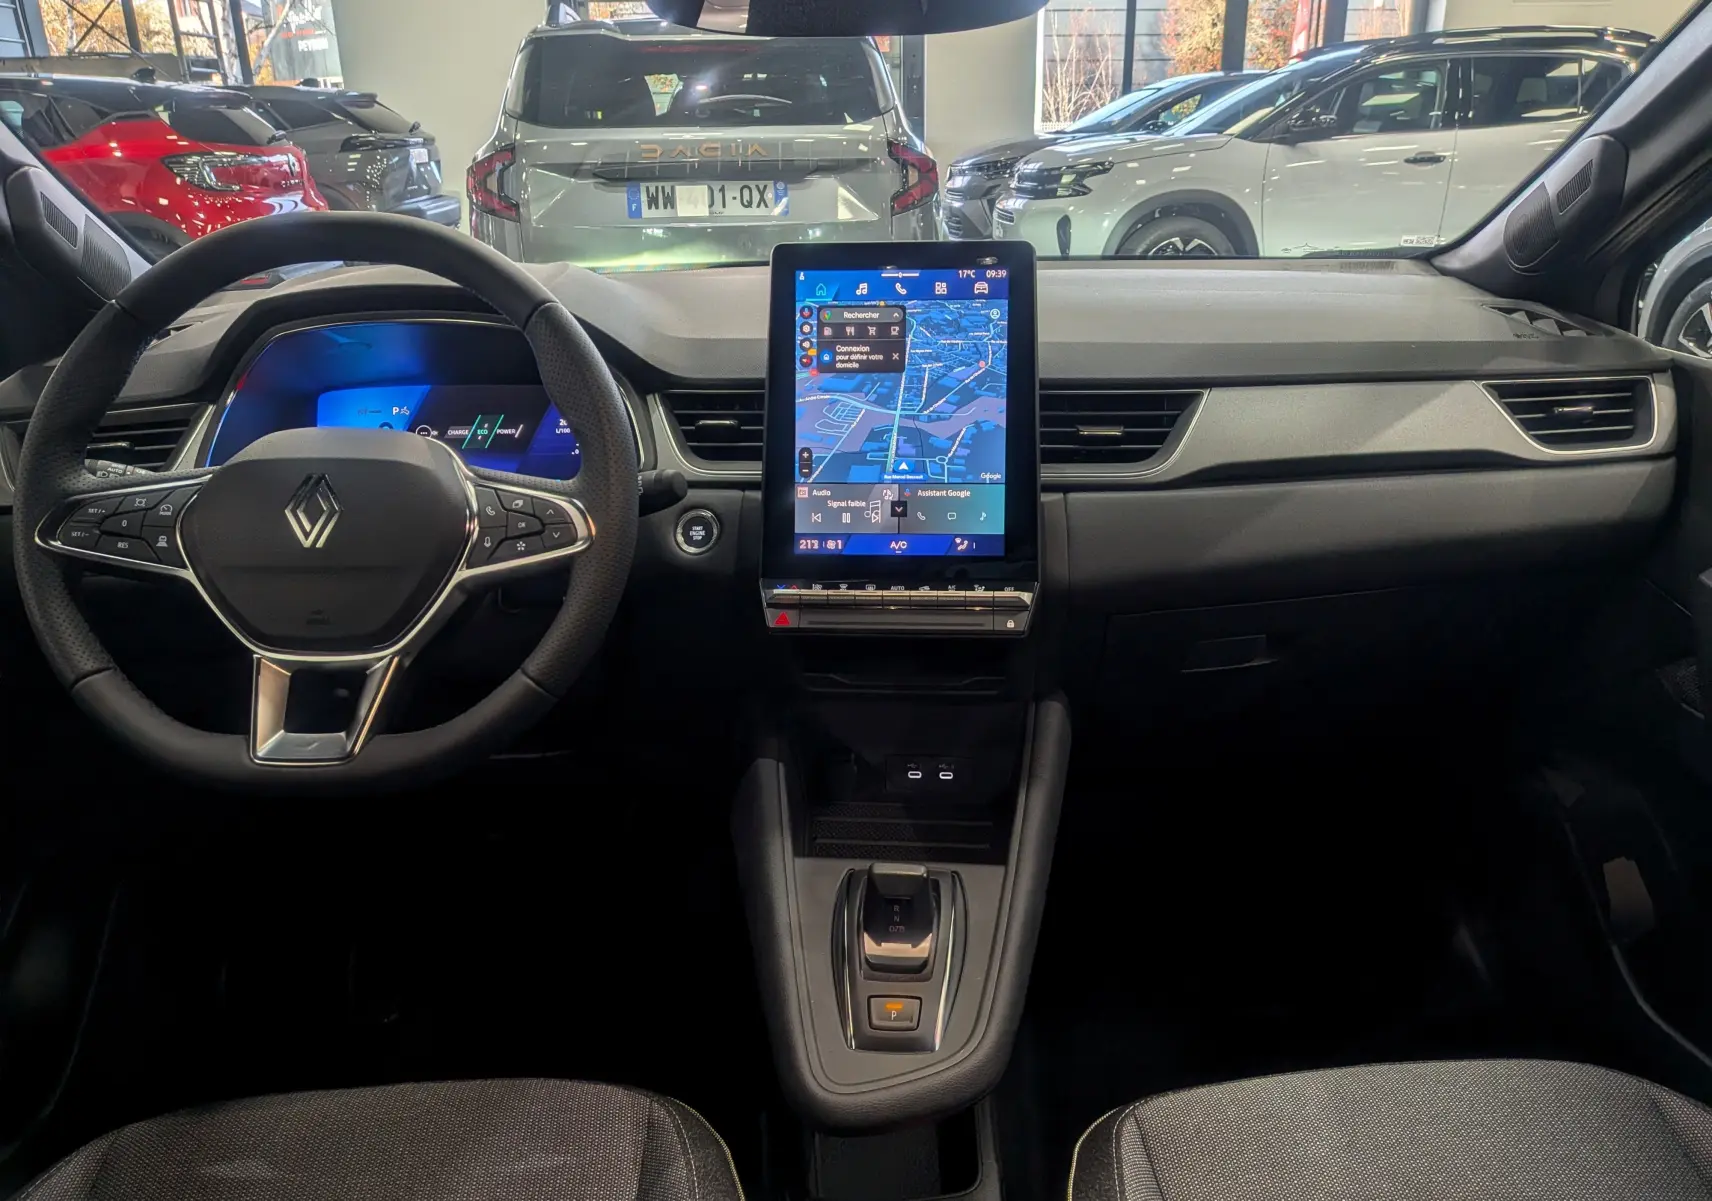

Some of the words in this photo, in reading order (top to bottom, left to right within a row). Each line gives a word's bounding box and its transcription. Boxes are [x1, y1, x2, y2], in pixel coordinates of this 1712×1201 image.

[640, 142, 769, 159] DACIA
[632, 204, 637, 212] F
[958, 269, 977, 279] 17°C
[985, 269, 1007, 279] 09:39
[843, 311, 880, 319] Rechercher
[835, 354, 849, 362] pour
[849, 353, 868, 361] définir
[392, 406, 400, 416] P
[447, 428, 470, 436] CHARGE
[980, 472, 1002, 480] Google
[917, 489, 947, 497] Assistant
[947, 489, 971, 498] Google
[827, 500, 847, 508] Signal
[117, 541, 129, 549] RES
[890, 540, 908, 550] A/C
[891, 1010, 897, 1021] P
